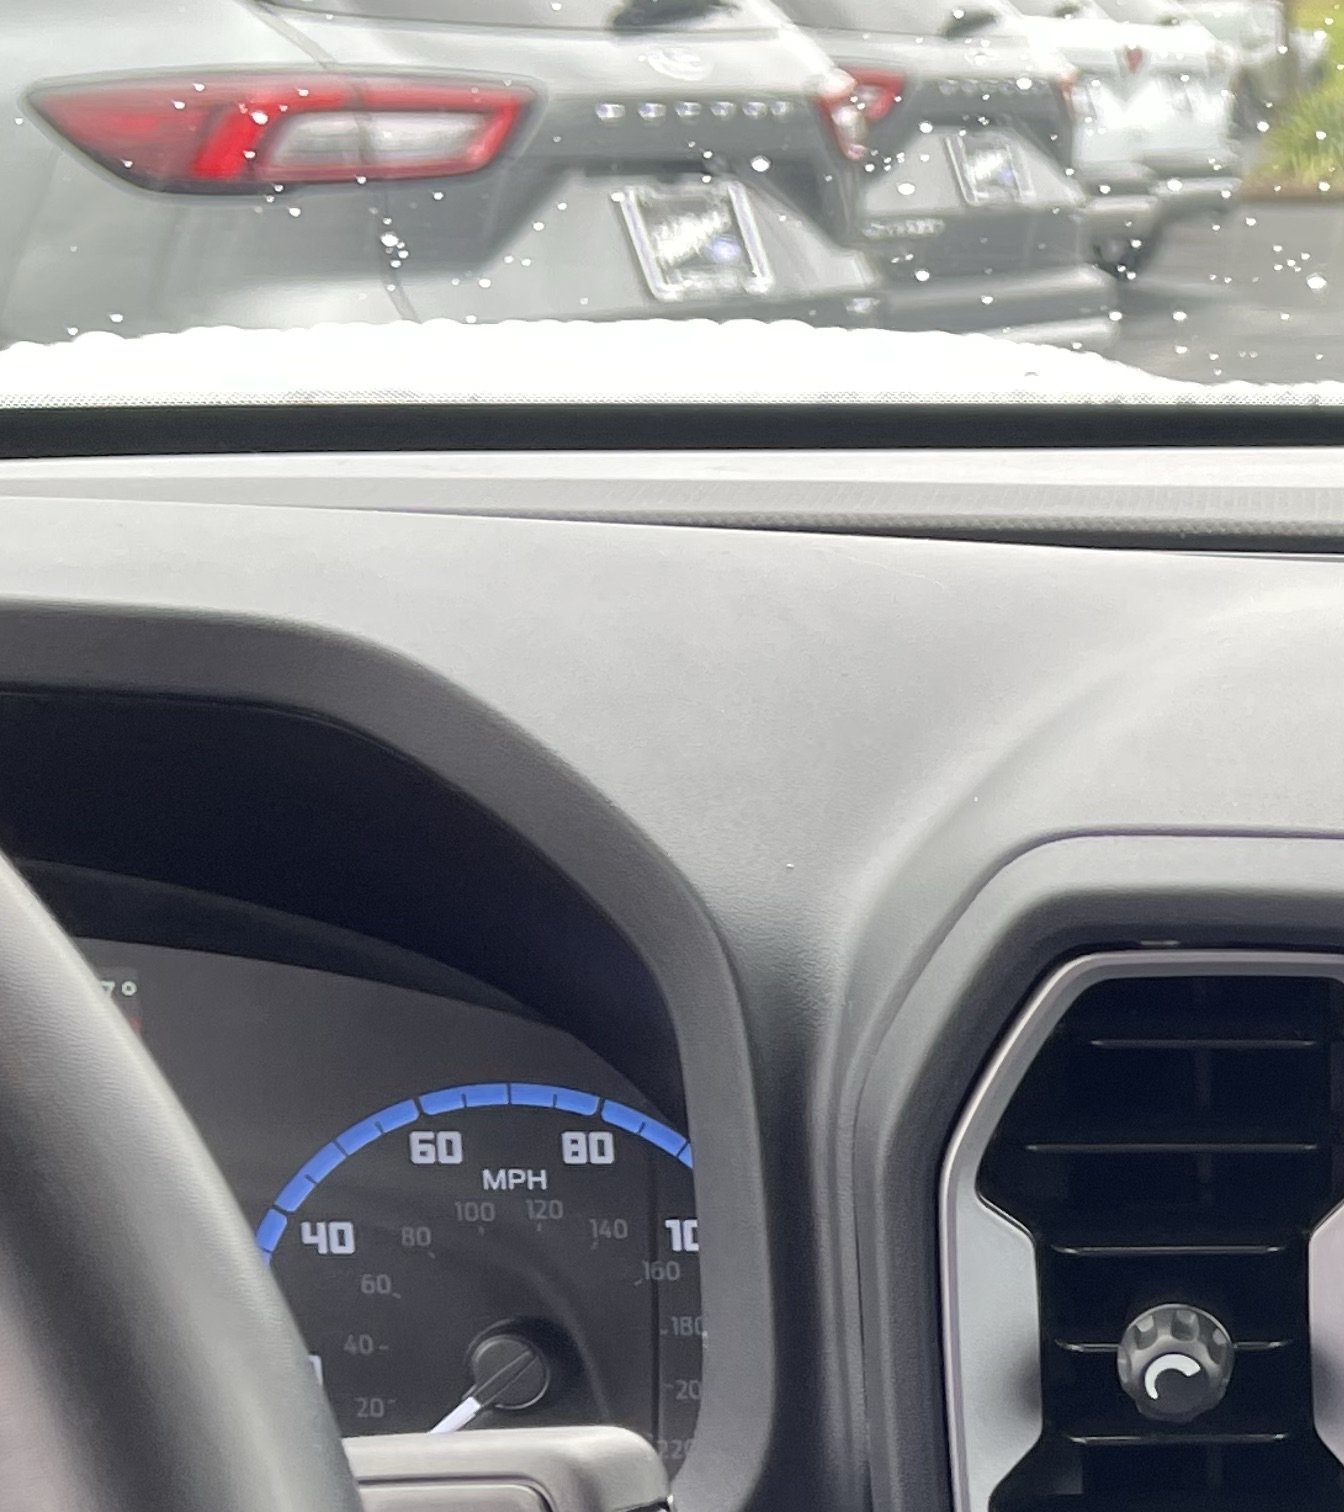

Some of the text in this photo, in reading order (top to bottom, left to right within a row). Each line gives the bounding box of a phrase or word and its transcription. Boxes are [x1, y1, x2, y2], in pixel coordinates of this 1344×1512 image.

[409, 1130, 463, 1165] 60
[561, 1130, 616, 1165] 80
[482, 1168, 548, 1191] MPH
[454, 1200, 496, 1223] 100
[526, 1199, 564, 1221] 120
[301, 1221, 356, 1255] 40
[401, 1226, 432, 1247] 80
[589, 1217, 629, 1240] 140
[642, 1260, 681, 1282] 160
[360, 1273, 392, 1295] 60
[356, 1397, 385, 1419] 20
